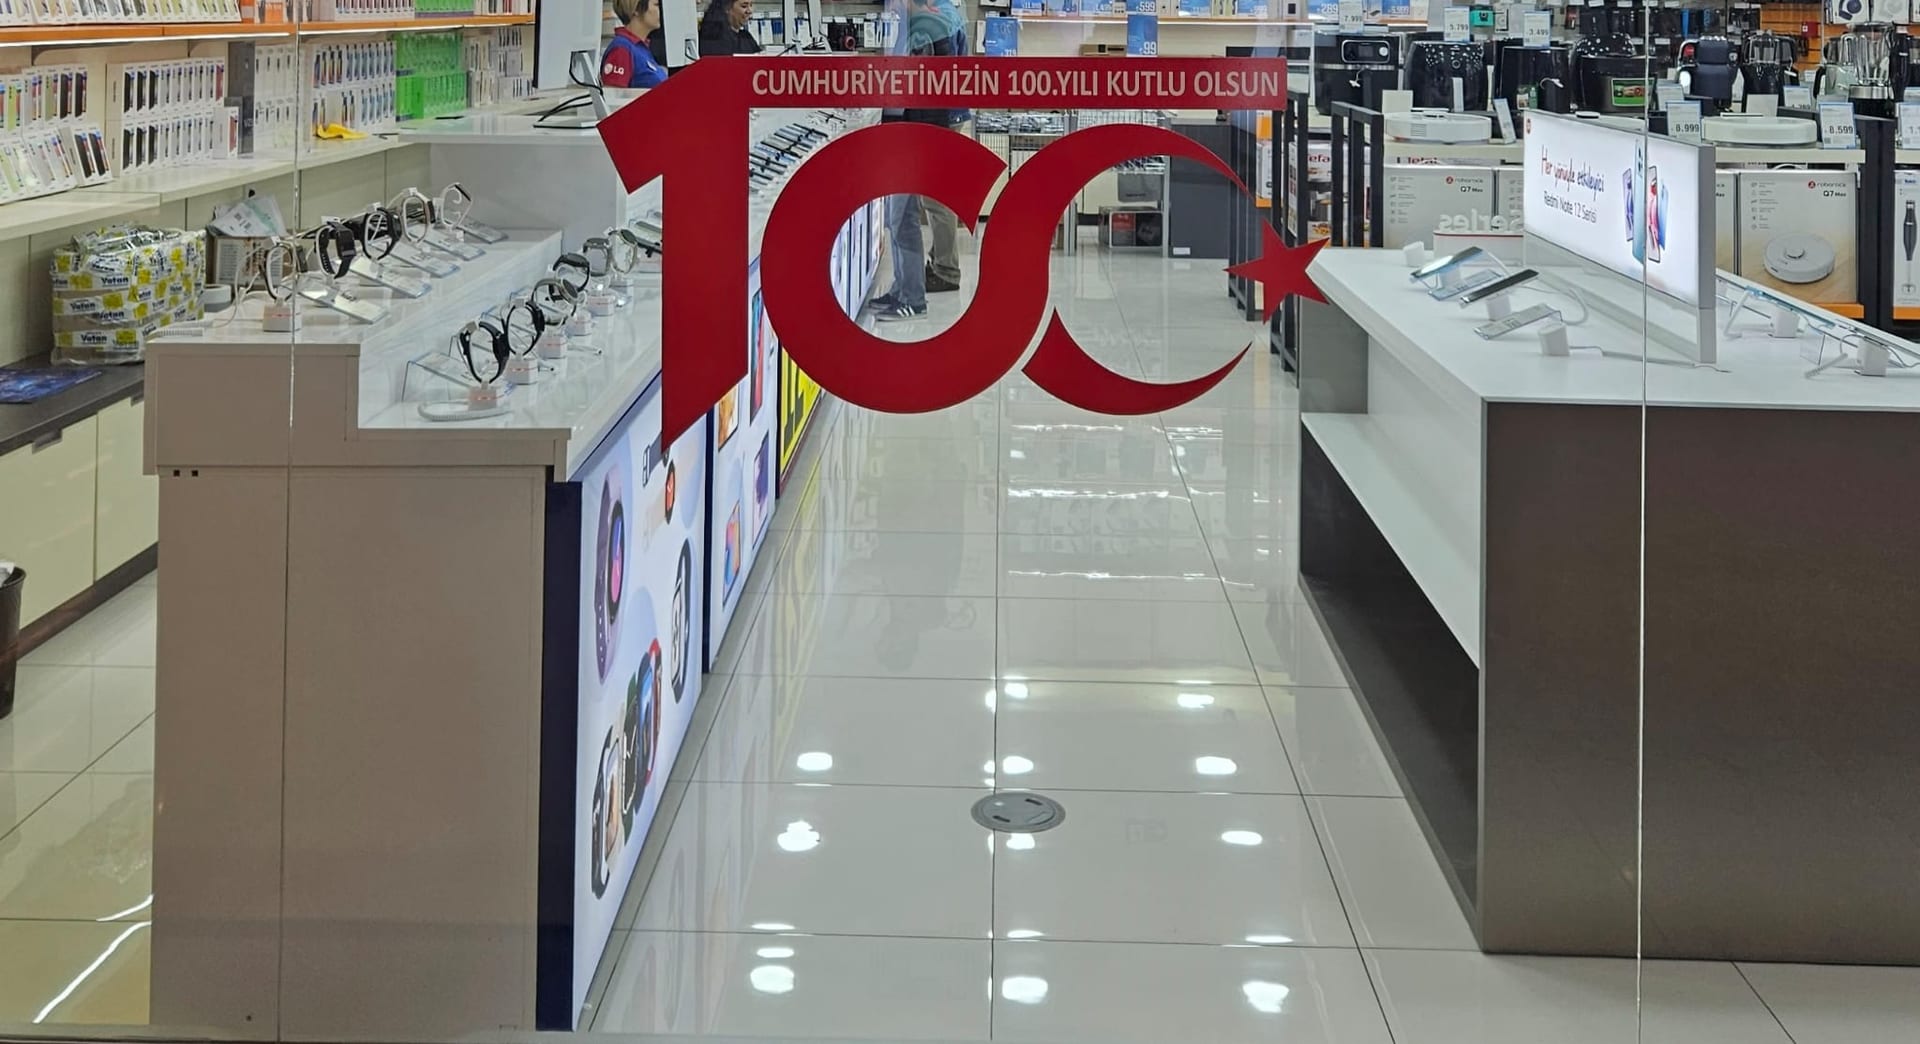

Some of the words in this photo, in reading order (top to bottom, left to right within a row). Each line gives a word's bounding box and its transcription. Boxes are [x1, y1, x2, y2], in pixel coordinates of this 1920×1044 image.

[613, 66, 625, 75] LG
[752, 64, 999, 96] CUMHURİYETİMİZİN
[1008, 70, 1099, 96] 100.YILI
[1107, 70, 1186, 96] KUTLU
[1193, 70, 1279, 97] OLSUN
[1541, 144, 1552, 176] Her
[1460, 185, 1471, 193] Q7
[1544, 190, 1558, 209] Redmi
[1560, 197, 1573, 215] Note
[1574, 201, 1581, 218] 12
[1582, 204, 1597, 223] Serisi
